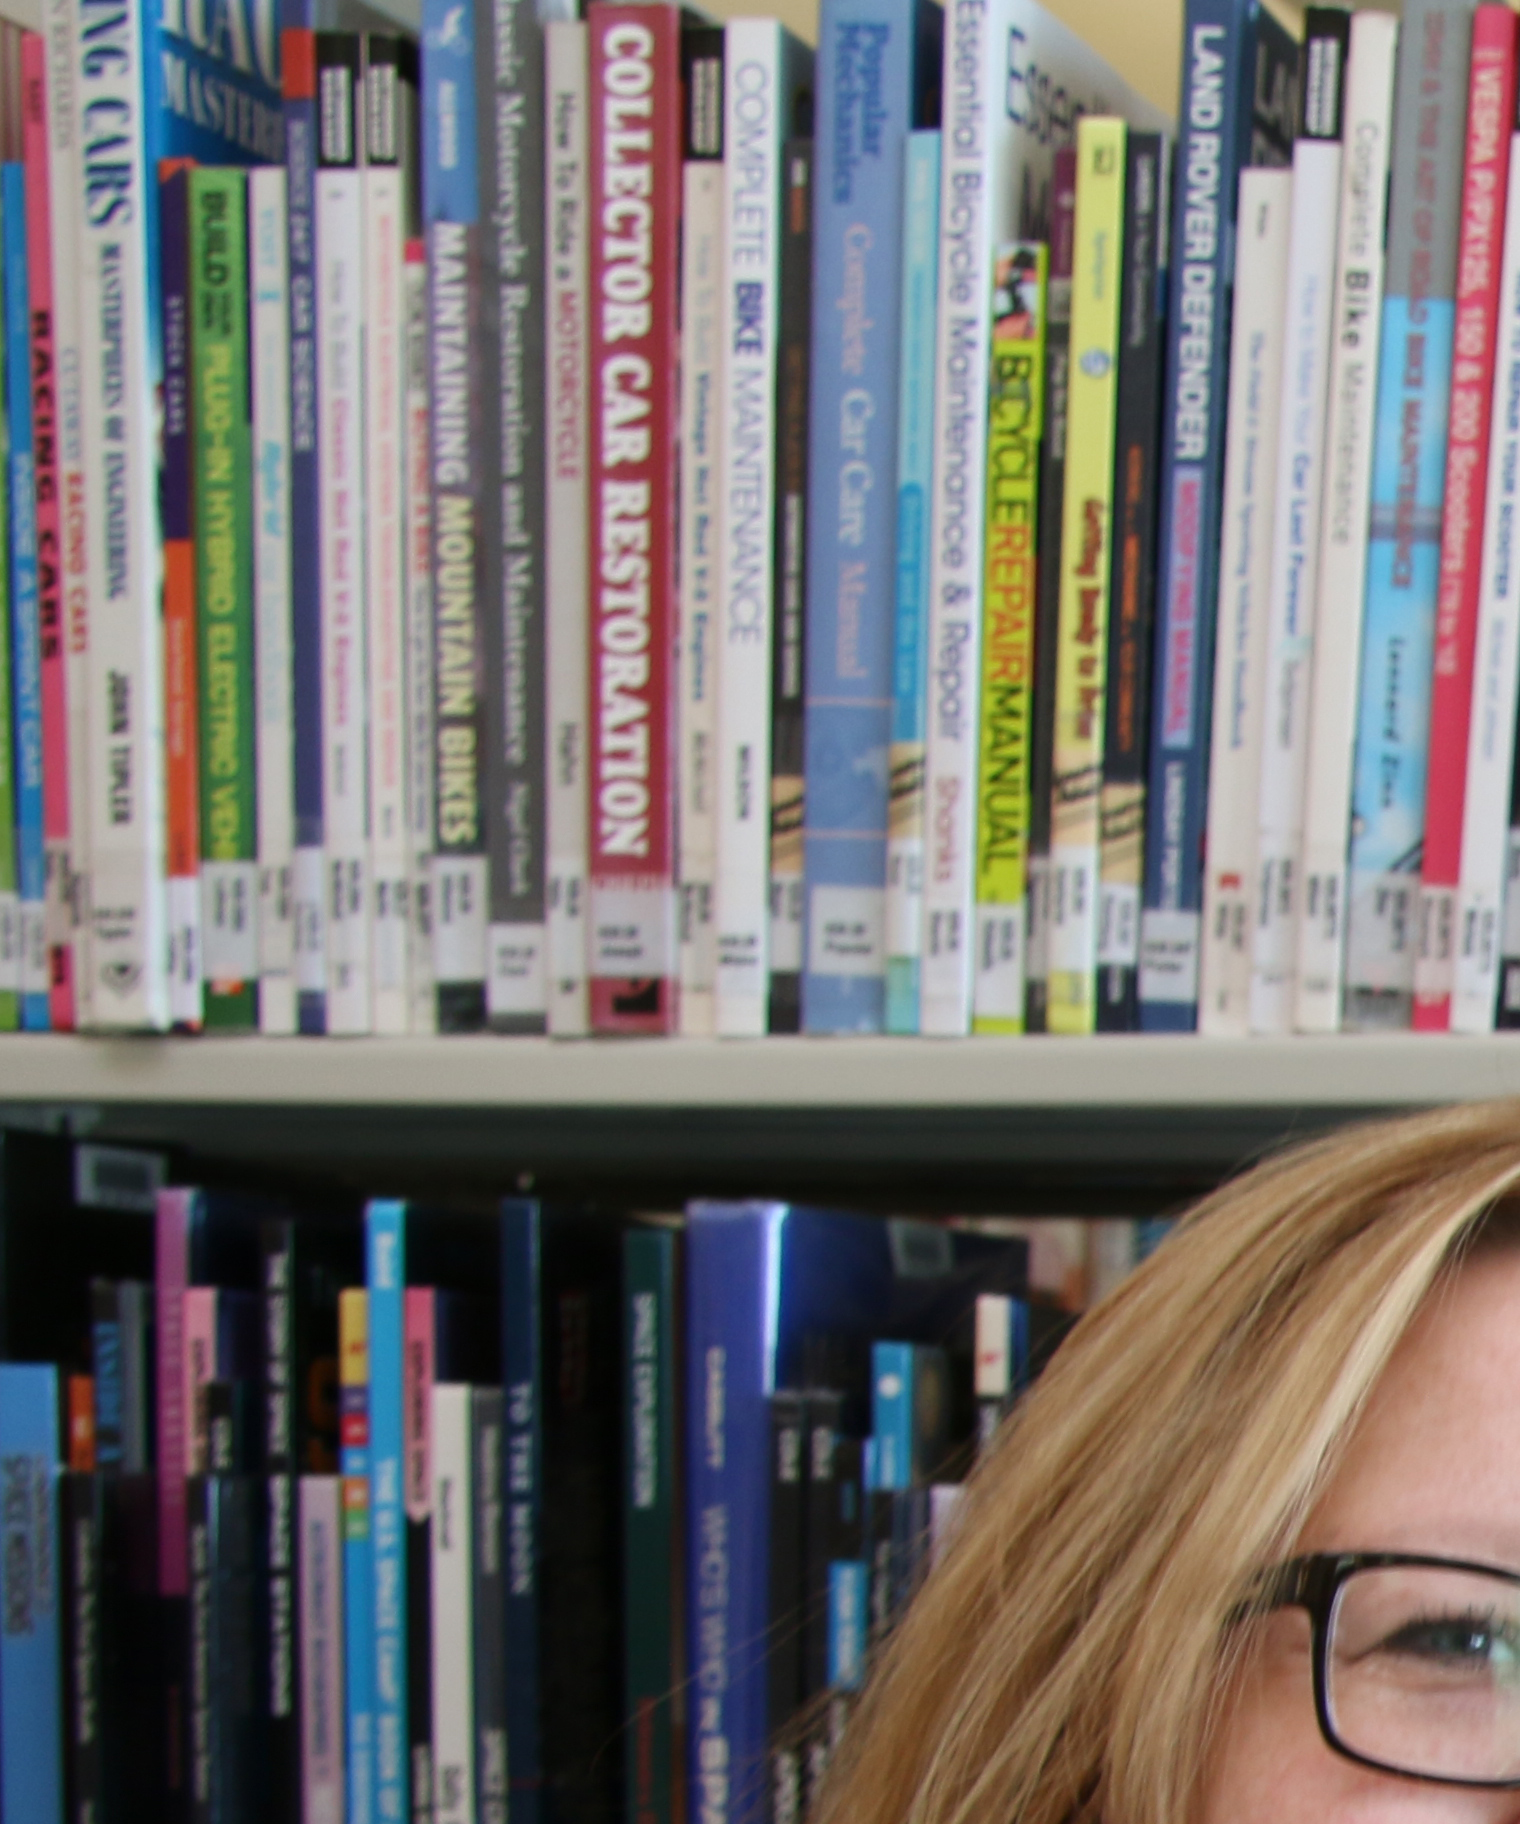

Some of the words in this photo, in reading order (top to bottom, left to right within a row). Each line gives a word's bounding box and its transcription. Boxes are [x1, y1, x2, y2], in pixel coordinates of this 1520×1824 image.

[557, 92, 578, 150] How
[834, 21, 863, 206] Mechanics
[863, 21, 892, 159] Popular
[952, 0, 987, 158] Essential
[1190, 24, 1226, 128] LAND
[1468, 65, 1502, 165] VESPA
[84, 98, 137, 228] CARS
[491, 93, 526, 277] Motorcycle
[602, 22, 653, 343] COLLECTOR
[733, 60, 769, 266] COMPLETE
[1184, 132, 1221, 261] ROVER
[1347, 119, 1380, 258] Complete
[202, 189, 229, 287] BUILD
[557, 200, 579, 257] Ride
[948, 171, 982, 305] Bicycle
[100, 243, 124, 410] MASTERPIECES
[167, 295, 185, 368] STOCK
[433, 221, 470, 486] MAINTAINING
[733, 281, 763, 353] BIKE
[837, 222, 875, 377] Complete
[1340, 269, 1372, 350] Bike
[1458, 306, 1487, 352] 150
[33, 310, 59, 510] RACING
[168, 377, 186, 435] CARS
[204, 343, 233, 480] PLUG-IN
[500, 283, 531, 477] Restoration
[556, 290, 581, 480] MOTORCYCLE
[601, 353, 651, 468] CAR
[1174, 265, 1215, 459] DEFENDER
[1405, 332, 1429, 390] BIKE
[1450, 388, 1480, 441] 200
[838, 388, 877, 455] Car
[942, 316, 980, 568] Maintenance
[1331, 362, 1366, 546] Maintenance
[67, 472, 85, 576] RACING
[106, 453, 129, 600] ENGINEERING
[207, 491, 237, 614] HYBRID
[501, 484, 529, 545] and
[729, 368, 766, 644] MAINTENANCE
[837, 461, 875, 548] Care
[1447, 450, 1477, 573] Scooters
[435, 496, 475, 715] MOUNTAIN
[836, 560, 869, 679] Manual
[941, 582, 969, 606] &
[1284, 553, 1304, 637] Forever
[108, 671, 132, 736] JOHN
[208, 625, 239, 777] ELECTRIC
[501, 553, 532, 766] Maintenance
[600, 480, 651, 859] RESTORATION
[933, 620, 972, 742] Repair
[1164, 628, 1194, 742] MANUAL
[110, 747, 133, 826] TIPLER
[439, 726, 477, 845] BIKES
[933, 777, 963, 883] Shanks
[633, 1294, 657, 1357] SPACE
[509, 1382, 533, 1424] TO
[633, 1364, 656, 1508] EXPLORATION
[510, 1434, 533, 1493] THE
[509, 1504, 533, 1595] MOON
[701, 1506, 727, 1608] WHO'S
[702, 1614, 729, 1689] WHO
